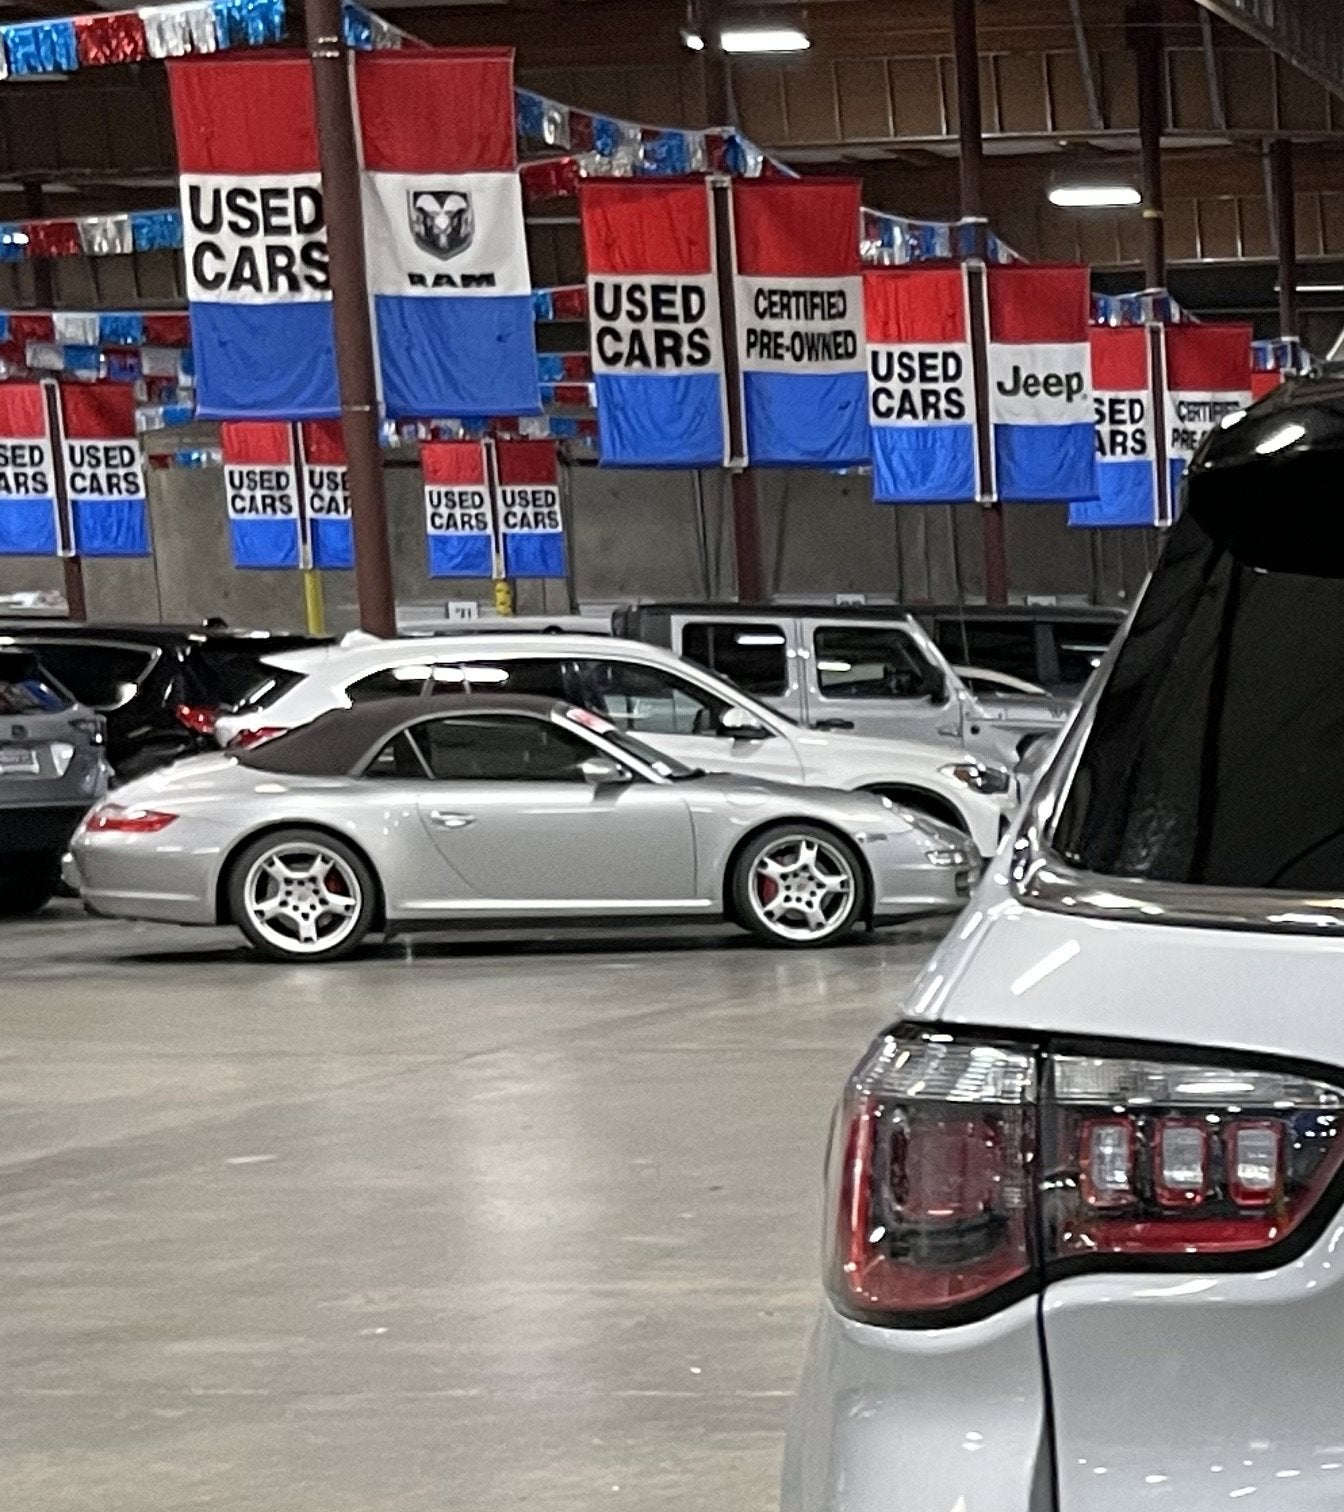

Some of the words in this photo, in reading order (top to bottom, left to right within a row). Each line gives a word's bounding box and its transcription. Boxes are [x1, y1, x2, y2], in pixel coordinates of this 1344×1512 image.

[188, 185, 326, 237] USED
[192, 241, 332, 293] CARS
[407, 272, 496, 288] RAM
[594, 282, 706, 324] USED
[754, 287, 847, 321] CERTIFIED
[596, 326, 711, 369] CARS
[746, 328, 857, 362] PRE-OWNED
[871, 350, 963, 384] USED
[997, 365, 1084, 402] Jeep
[872, 387, 966, 420] CARS
[1093, 397, 1145, 425] SED
[1095, 428, 1147, 456] ARS
[0, 445, 44, 468] SED
[69, 444, 135, 469] USED
[0, 472, 48, 494] ARS
[70, 472, 140, 495] CARS
[229, 470, 290, 491] USED
[309, 469, 350, 491] USE
[231, 494, 293, 515] CARS
[428, 490, 484, 509] USED
[502, 490, 556, 508] USED
[430, 512, 488, 531] CARS
[504, 511, 559, 530] CARS
